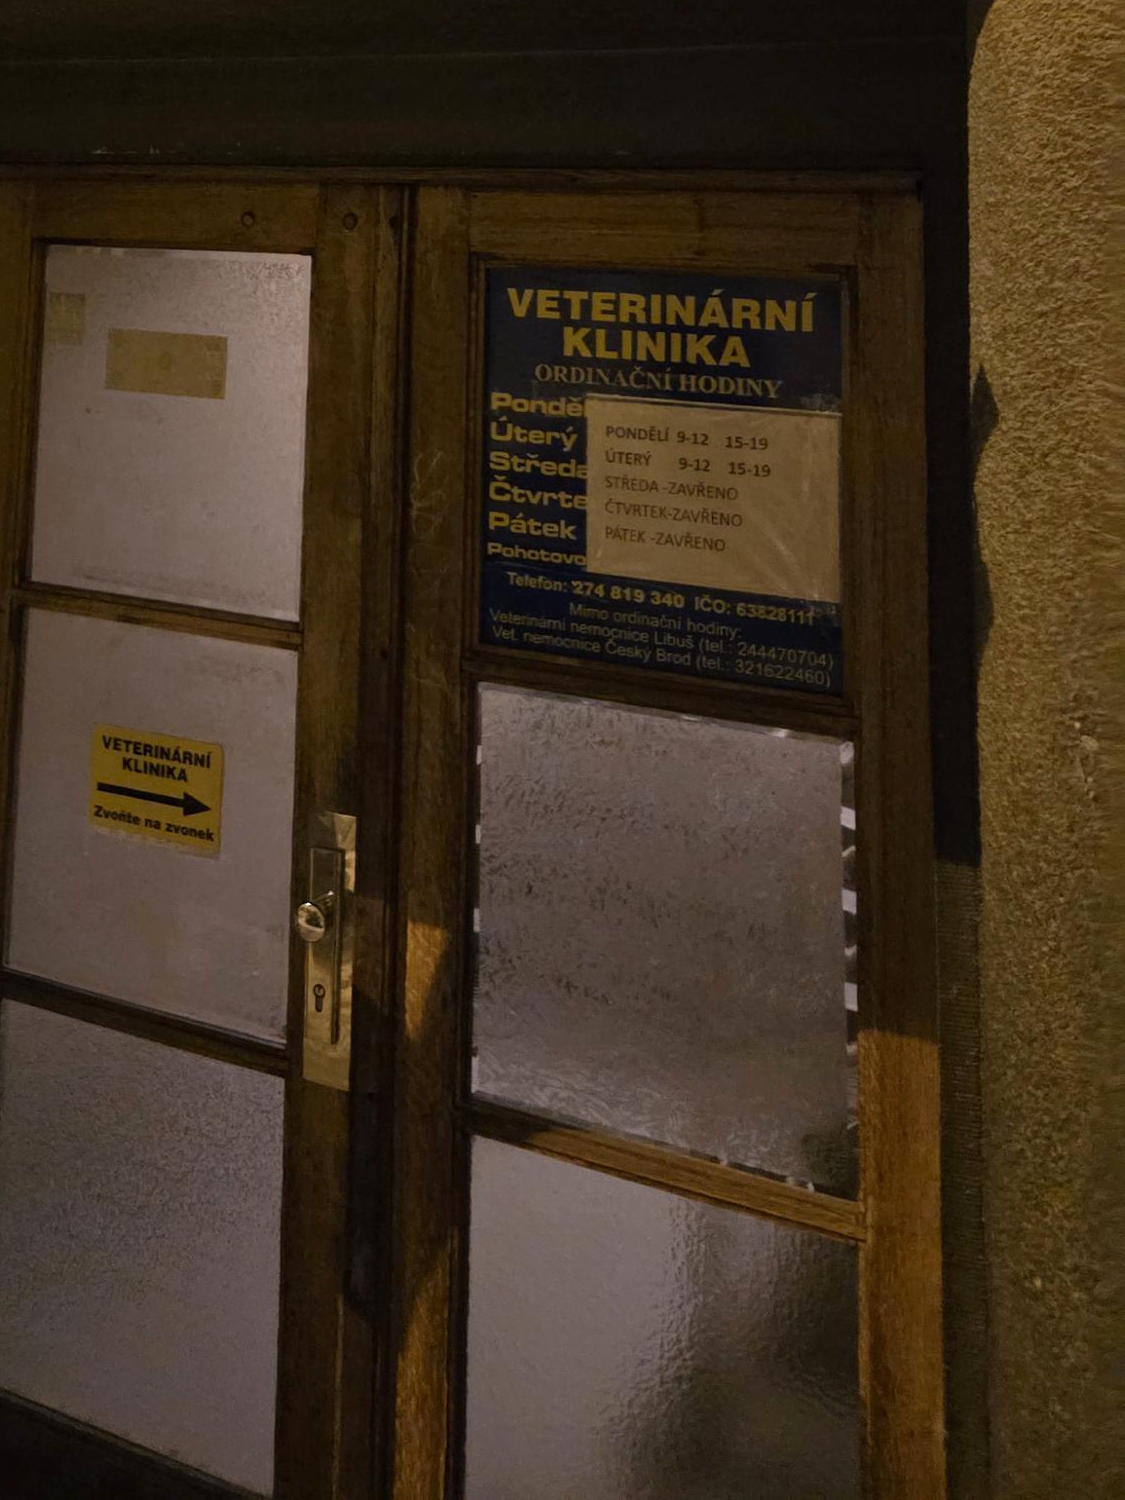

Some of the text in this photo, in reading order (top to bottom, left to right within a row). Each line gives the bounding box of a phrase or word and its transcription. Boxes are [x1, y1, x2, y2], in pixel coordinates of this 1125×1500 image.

[507, 287, 818, 332] VETERINÁRNÍ
[562, 327, 751, 368] KLINIKA
[535, 363, 783, 398] ORDINAČNÍ HODINY
[490, 415, 578, 452] Úterý
[605, 425, 768, 450] PONDĚLÍ 9-12 15-19
[489, 451, 587, 479] Středa
[605, 448, 771, 477] ÚTERÝ 9-12 15-19
[605, 474, 660, 493] STŘEDA
[489, 511, 577, 540] Pátek
[605, 525, 647, 543] PÁTEK
[507, 572, 568, 593] Telefon:
[572, 580, 605, 597] 274
[610, 586, 645, 603] 819
[651, 591, 684, 608] 340
[694, 594, 732, 616] IČO:
[569, 602, 610, 621] Mimo
[570, 622, 649, 643] nemocnice
[654, 631, 694, 649] Libuš
[605, 637, 651, 663] Český
[656, 648, 691, 666] Brod
[102, 735, 212, 768] VETERINÁRNÍ
[122, 756, 188, 782] KLINIKA
[144, 817, 162, 830] na
[165, 822, 215, 842] zvonek
